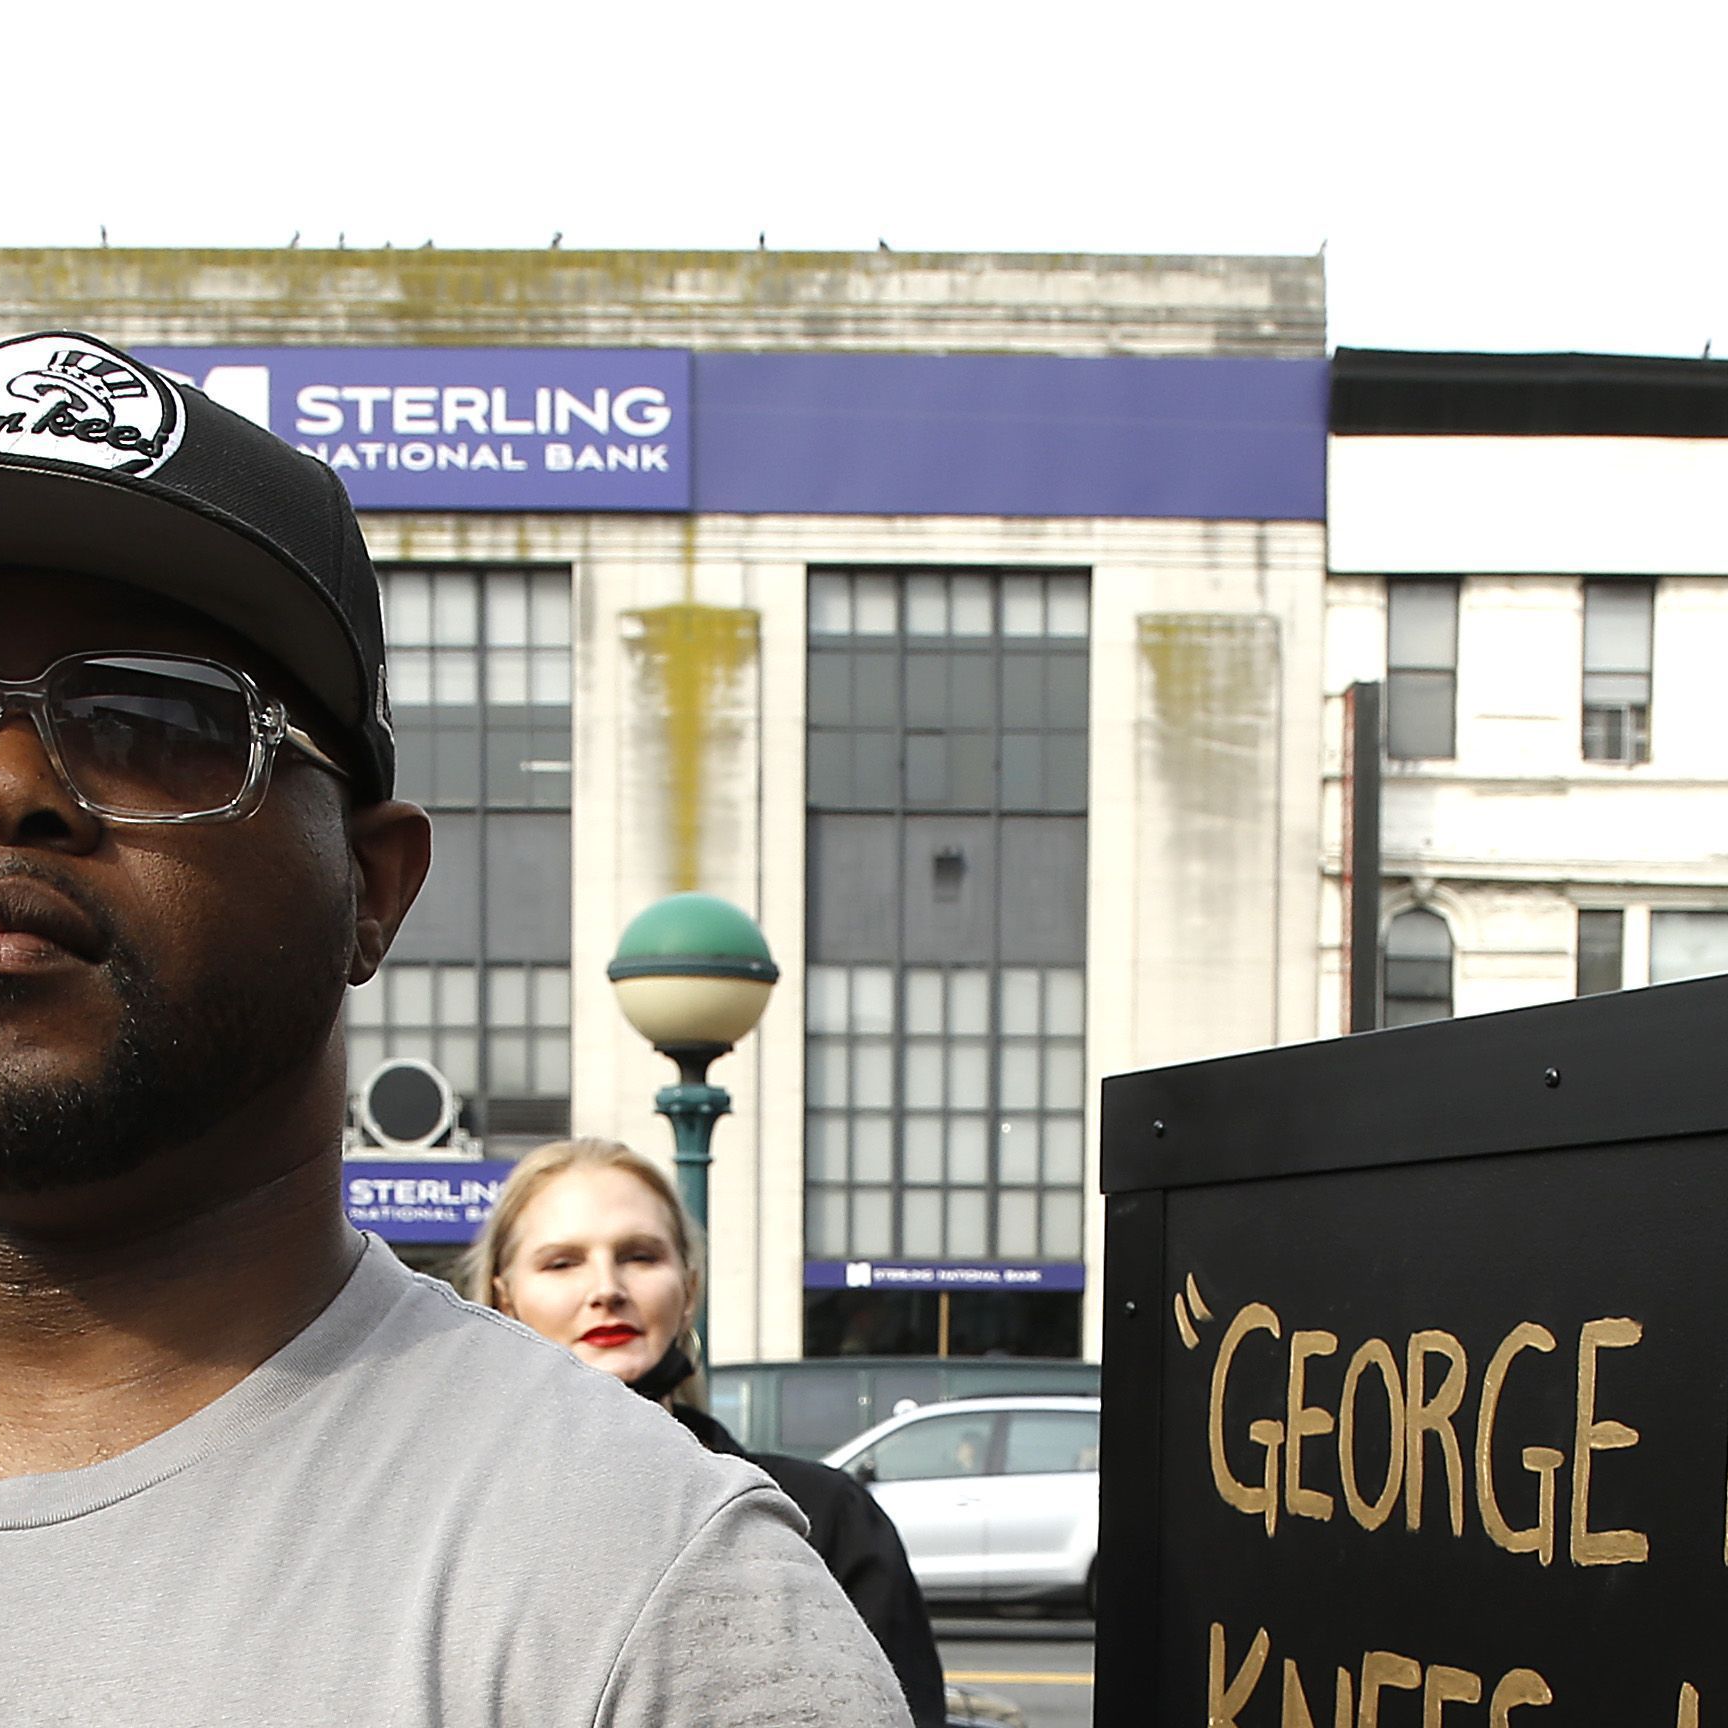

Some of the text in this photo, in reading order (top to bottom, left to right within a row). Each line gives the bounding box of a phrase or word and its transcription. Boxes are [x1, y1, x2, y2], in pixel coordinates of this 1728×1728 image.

[294, 384, 672, 437] STERLING
[297, 442, 671, 472] NATIONAL BANK
